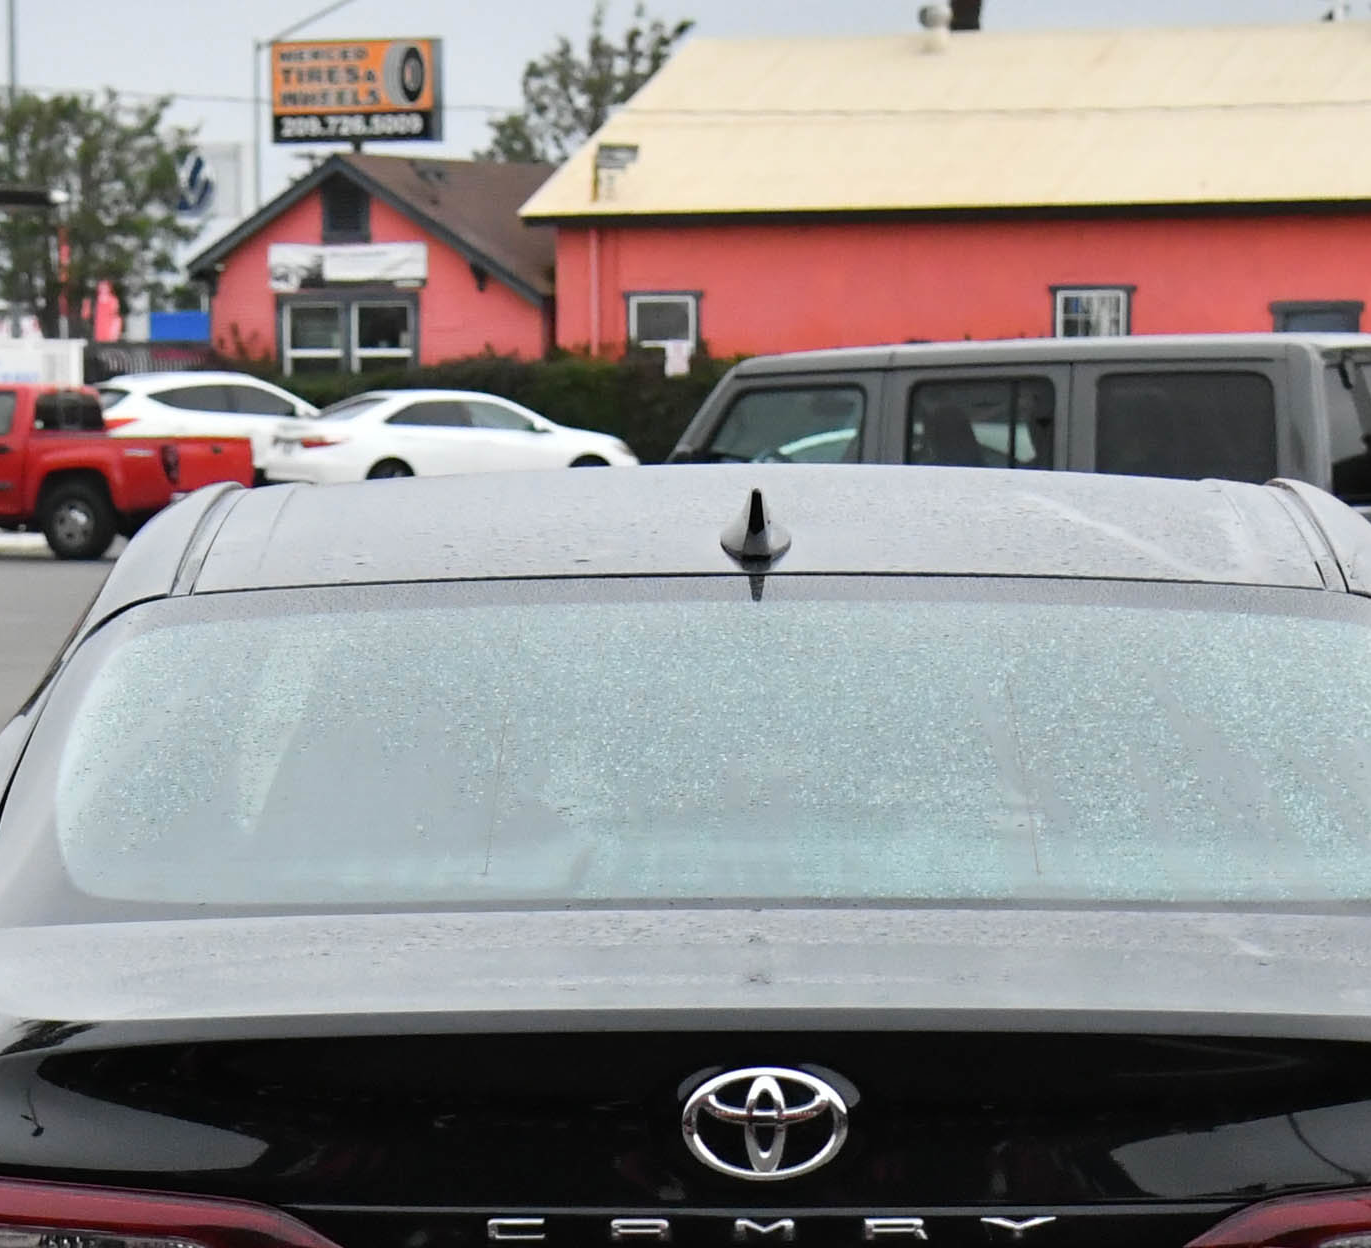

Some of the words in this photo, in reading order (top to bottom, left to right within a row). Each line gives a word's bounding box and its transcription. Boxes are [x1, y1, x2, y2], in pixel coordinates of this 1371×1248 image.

[281, 66, 360, 84] TIRES
[281, 88, 381, 107] WHEELS
[487, 1217, 1056, 1241] CAMRY
